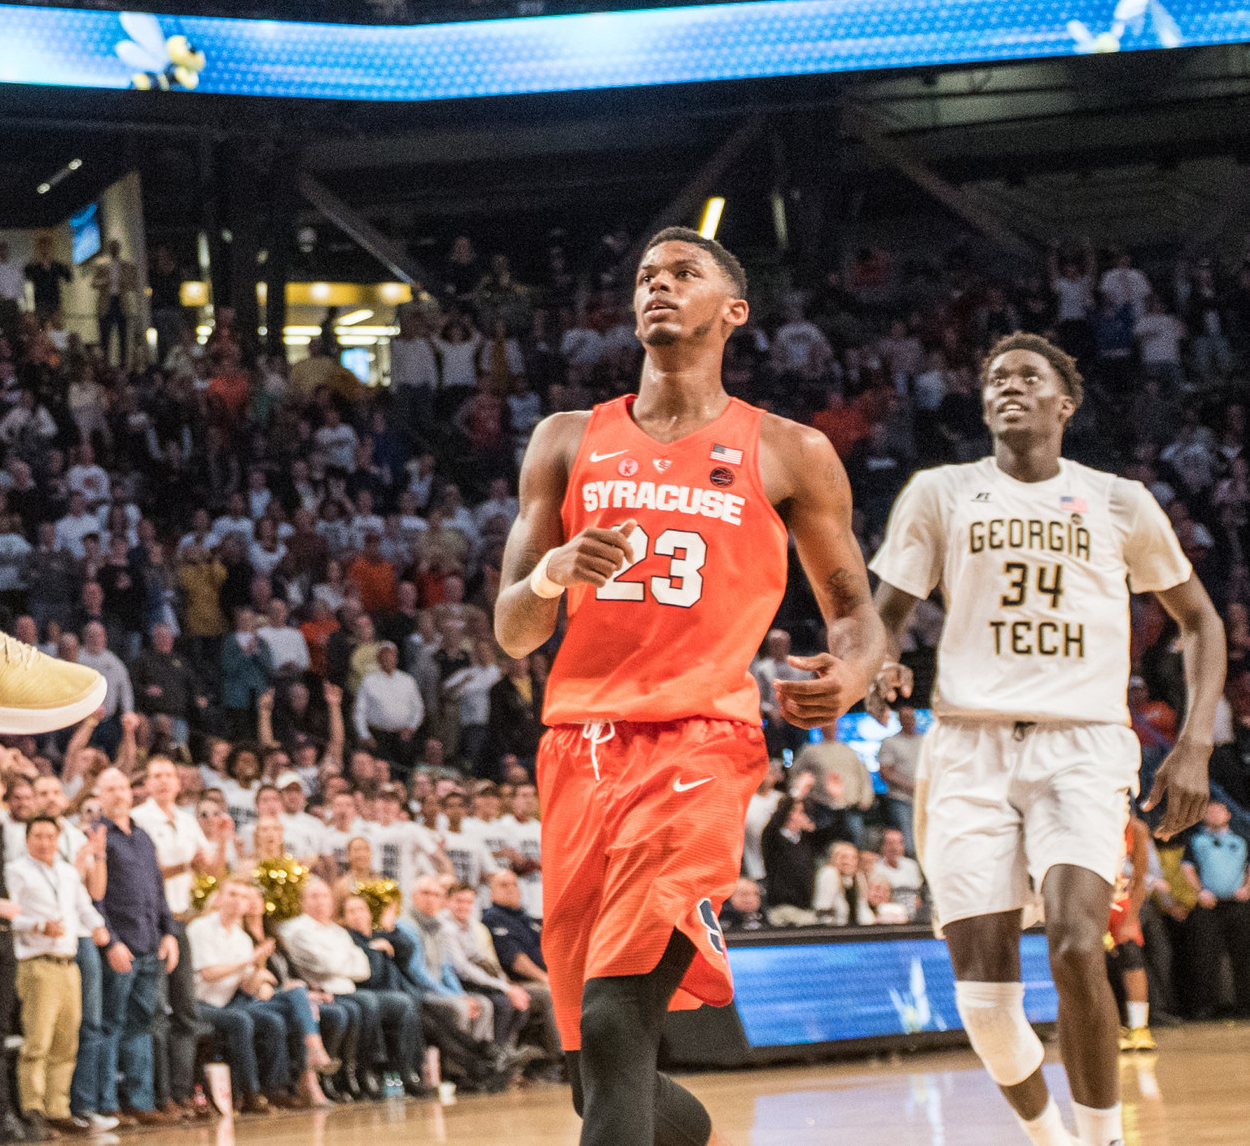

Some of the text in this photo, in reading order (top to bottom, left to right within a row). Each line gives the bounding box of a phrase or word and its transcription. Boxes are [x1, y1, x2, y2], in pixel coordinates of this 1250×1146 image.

[582, 480, 746, 527] SYRACUSE
[969, 517, 1091, 561] GEORGIA
[595, 524, 708, 609] 23
[1000, 560, 1065, 610] 34
[989, 620, 1085, 659] TECH
